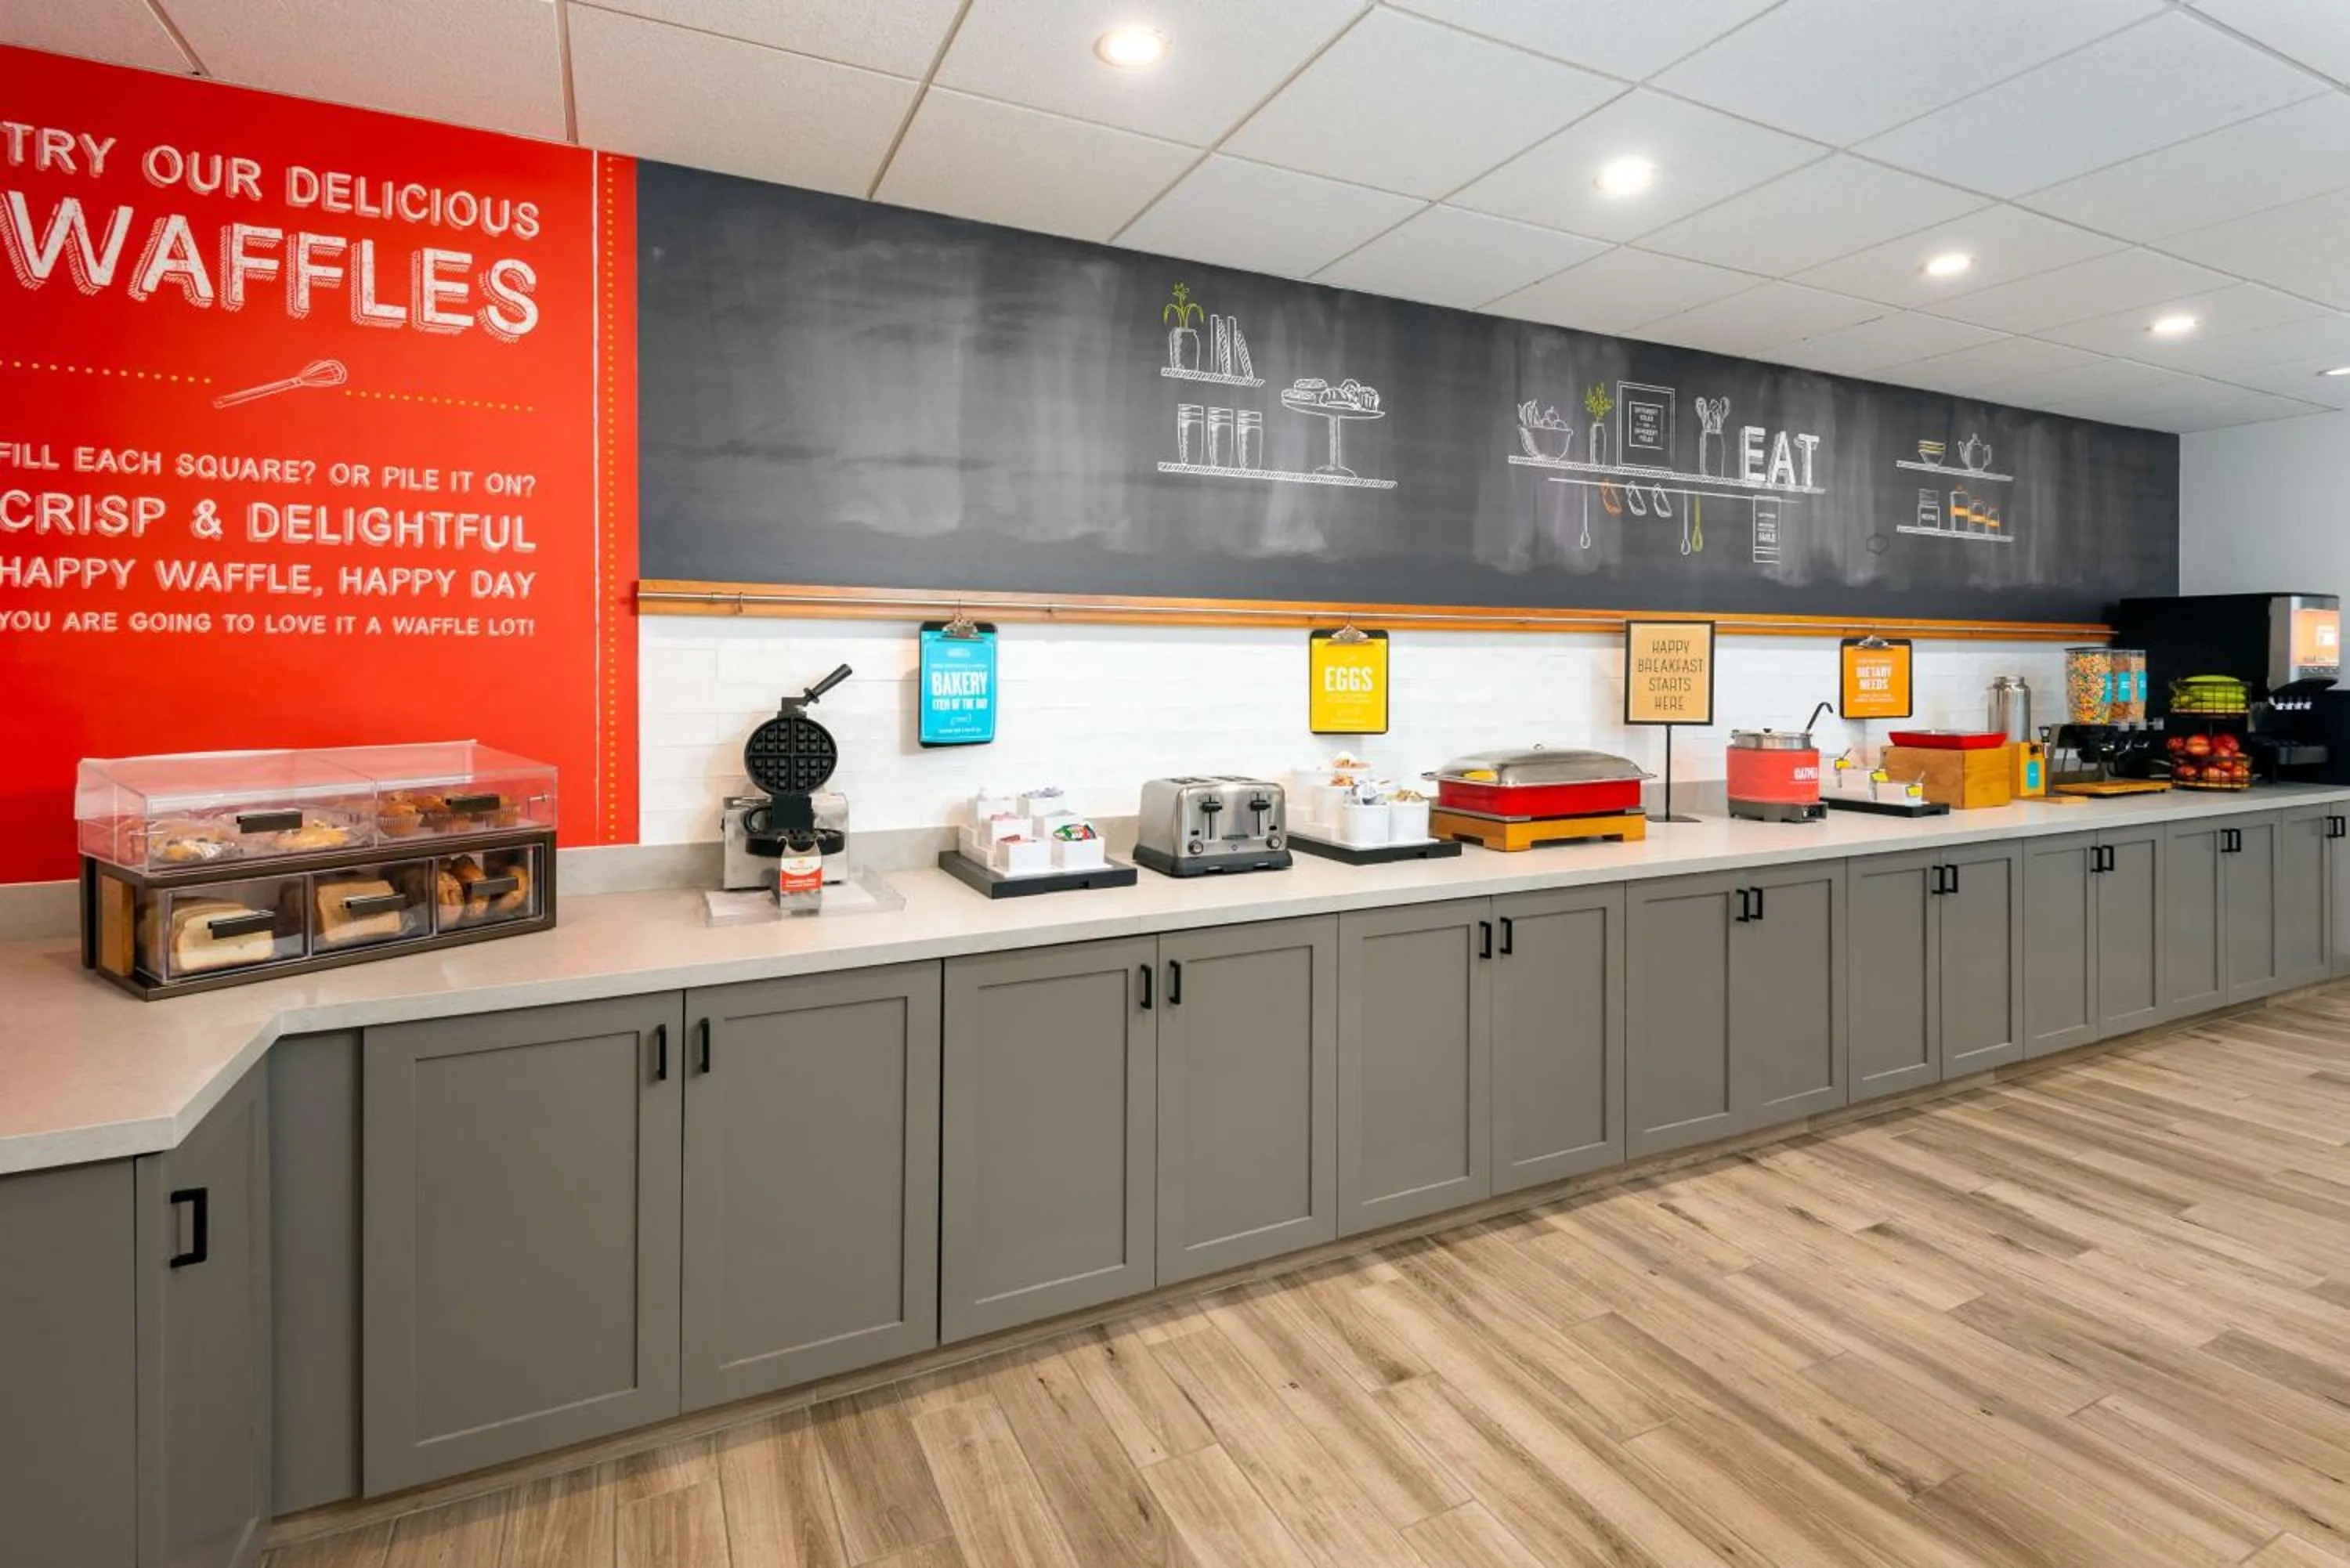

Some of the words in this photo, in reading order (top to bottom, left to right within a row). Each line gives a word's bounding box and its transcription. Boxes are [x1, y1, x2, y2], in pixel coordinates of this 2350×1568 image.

[0, 121, 117, 178] TRY
[142, 145, 262, 201] OUR
[286, 166, 540, 241] DELICIOUS
[0, 190, 538, 343] WAFFLES
[1740, 425, 1820, 487] EAT
[0, 443, 60, 470] FILL
[74, 446, 161, 475] EACH
[175, 453, 316, 484] SQUARE?
[329, 463, 370, 487] OR
[382, 466, 439, 493] PILE
[450, 471, 474, 494] IT
[485, 472, 537, 497] ON?
[0, 490, 166, 538] CRISP
[190, 498, 223, 540] &
[247, 502, 537, 553] DELIGHTFUL
[0, 555, 136, 590] HAPPY
[154, 559, 324, 598] WAFFLE,
[339, 566, 456, 598] HAPPY
[471, 569, 537, 599] DAY
[0, 610, 51, 632] YOU
[63, 612, 118, 632] ARE
[129, 612, 212, 634] GOING
[222, 613, 255, 634] TO
[265, 614, 327, 634] LOVE
[335, 616, 356, 634] IT
[365, 616, 382, 635] A
[393, 616, 480, 636] WAFFLE
[488, 618, 534, 637] LOT!
[1652, 639, 1690, 654] HAPPY
[1638, 658, 1703, 673] BREAKFAST
[931, 671, 988, 696] BAKERY
[1325, 667, 1373, 692] EGGS
[1649, 677, 1691, 692] STARTS
[1654, 695, 1684, 710] HERE
